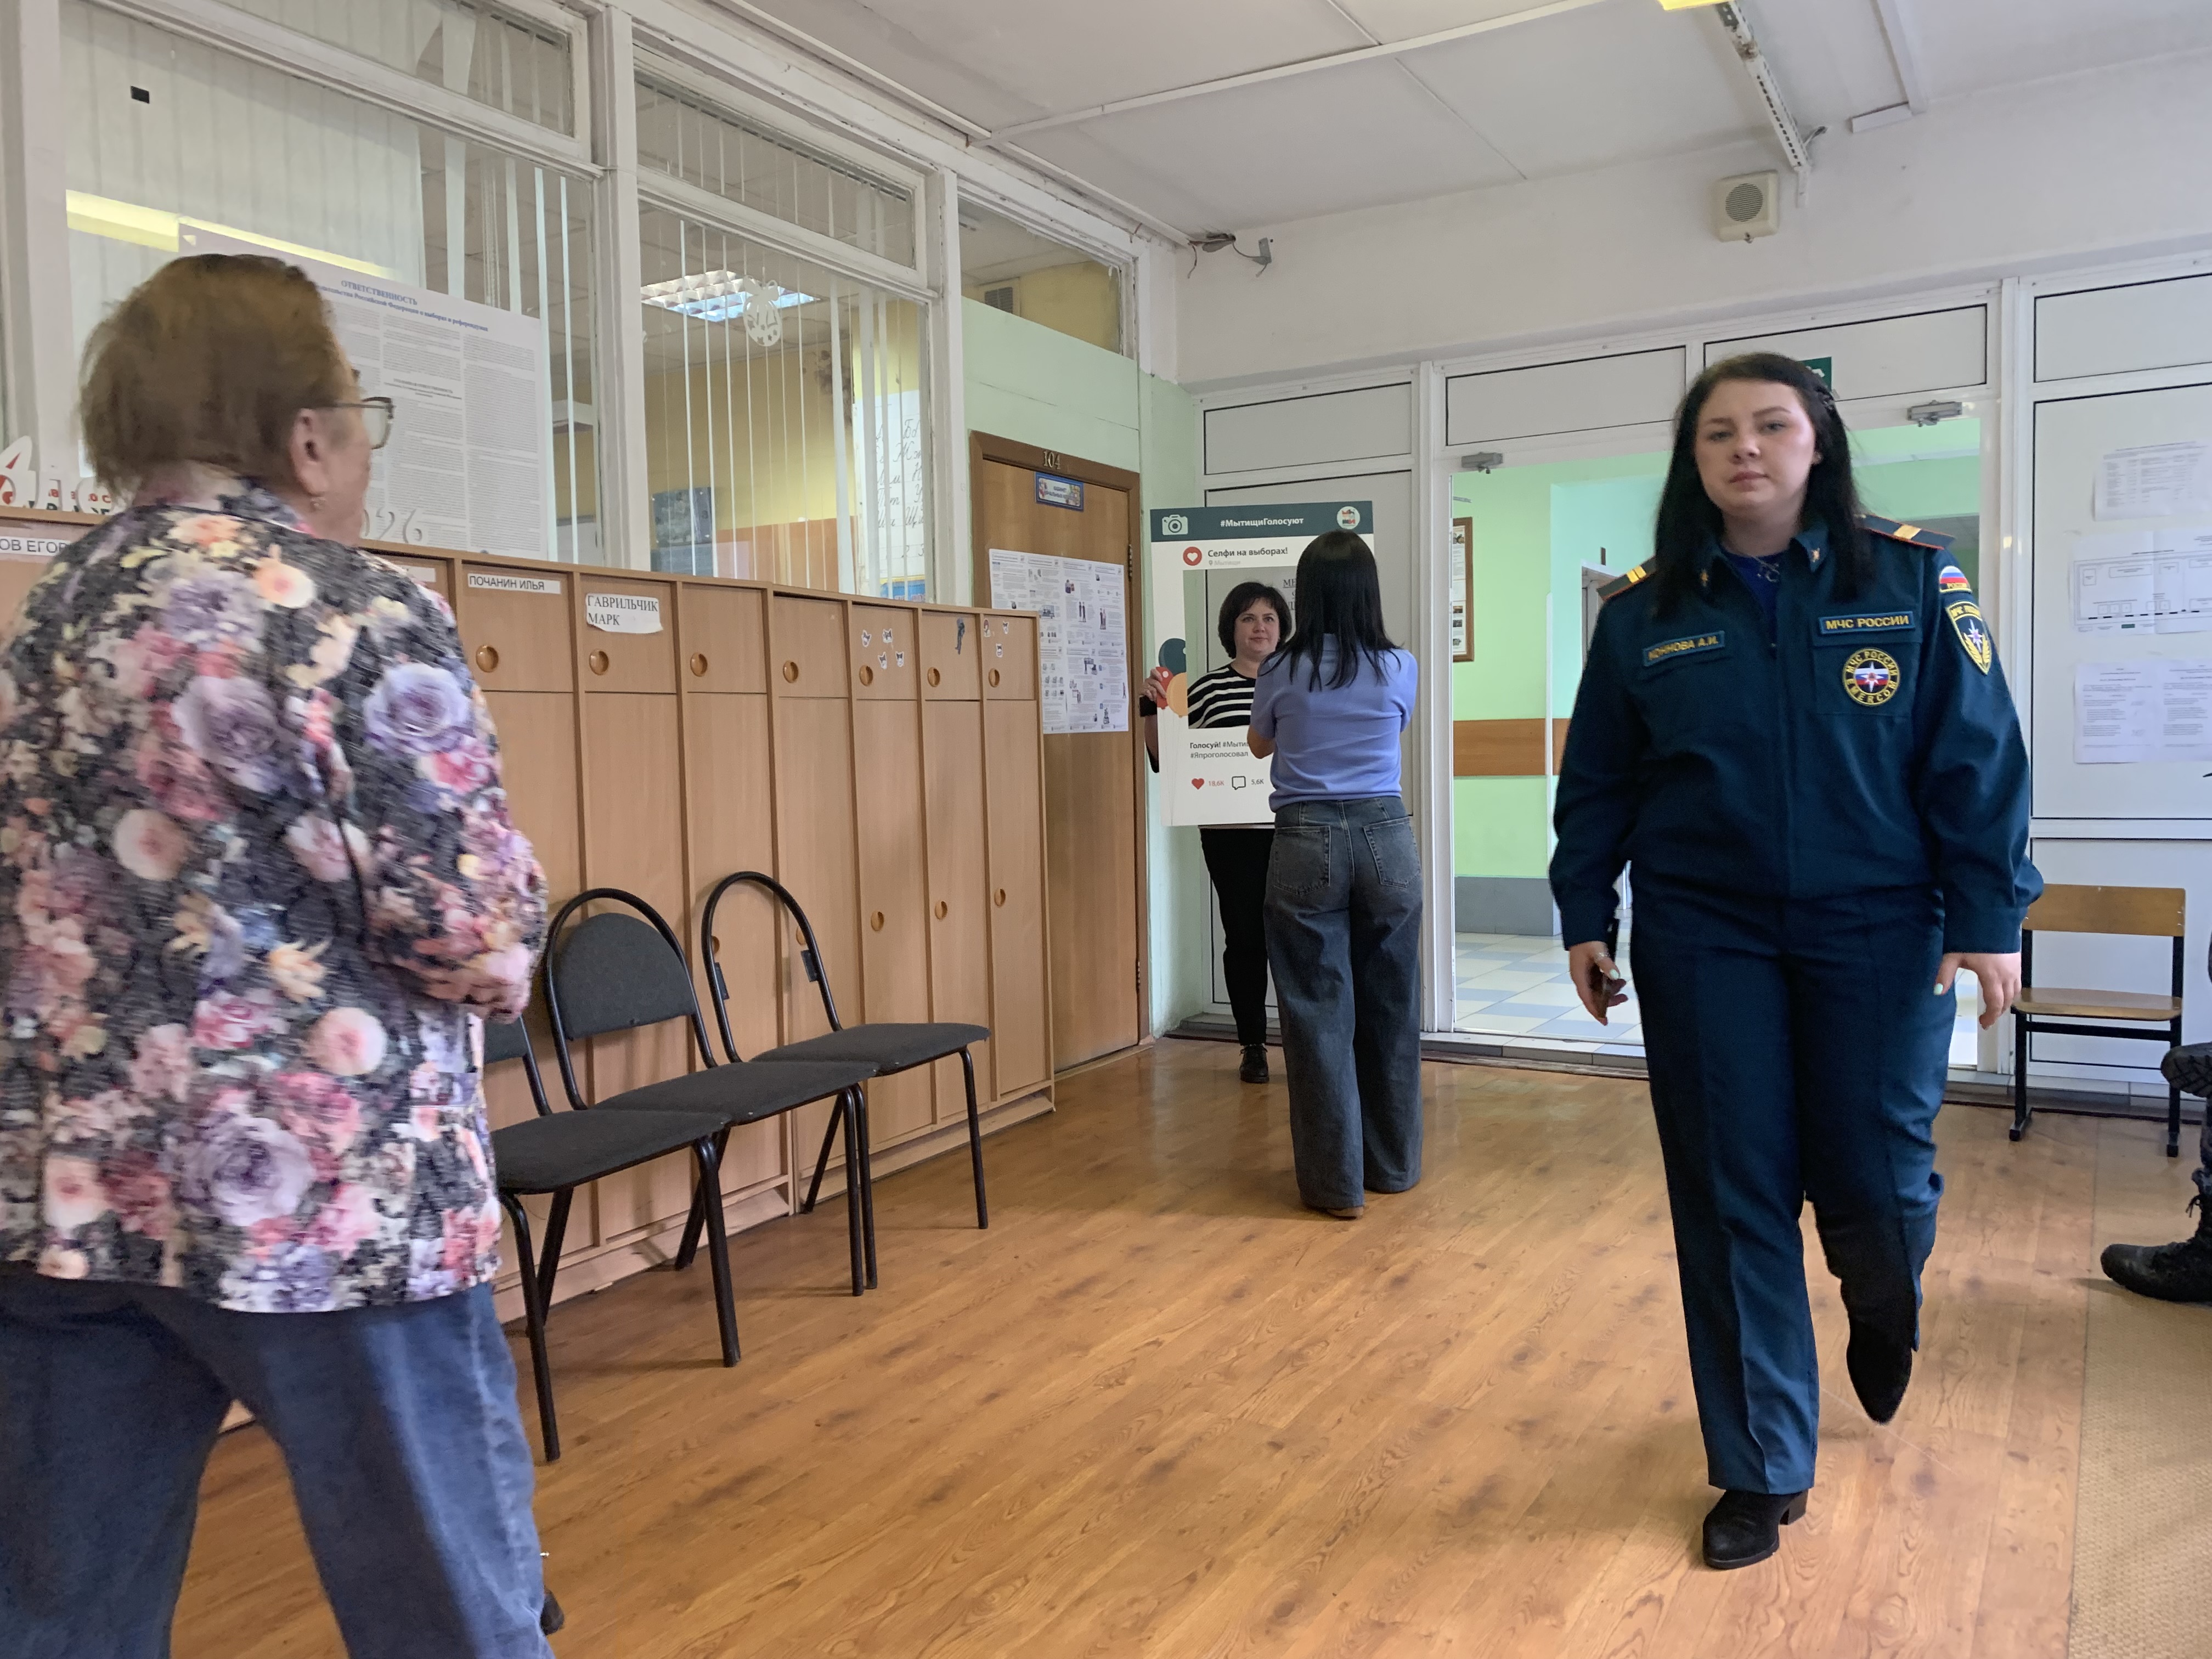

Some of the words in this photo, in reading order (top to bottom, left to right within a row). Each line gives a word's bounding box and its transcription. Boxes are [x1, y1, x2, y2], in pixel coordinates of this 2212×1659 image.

[341, 280, 417, 306] ОТВЕТСТВЕННОСТЬ
[354, 292, 387, 306] Российской
[388, 302, 419, 313] Федерации
[424, 312, 447, 321] выборах
[1043, 451, 1061, 470] 104
[1220, 517, 1304, 527] #МытищиГолосуют
[1207, 549, 1235, 558] Селфи
[1249, 547, 1288, 556] выборах!
[469, 575, 517, 589] ПОЧАНИН
[520, 580, 545, 591] ИЛЬЯ
[588, 595, 658, 612] ГАВРИЛЬЧИК
[588, 612, 620, 625] МАРК
[1826, 619, 1854, 630] МЧС
[1857, 615, 1909, 628] РОССИИ
[1846, 654, 1863, 673] МЧС
[1864, 651, 1898, 676] РОССИИ
[1846, 678, 1897, 704] EMERCOM
